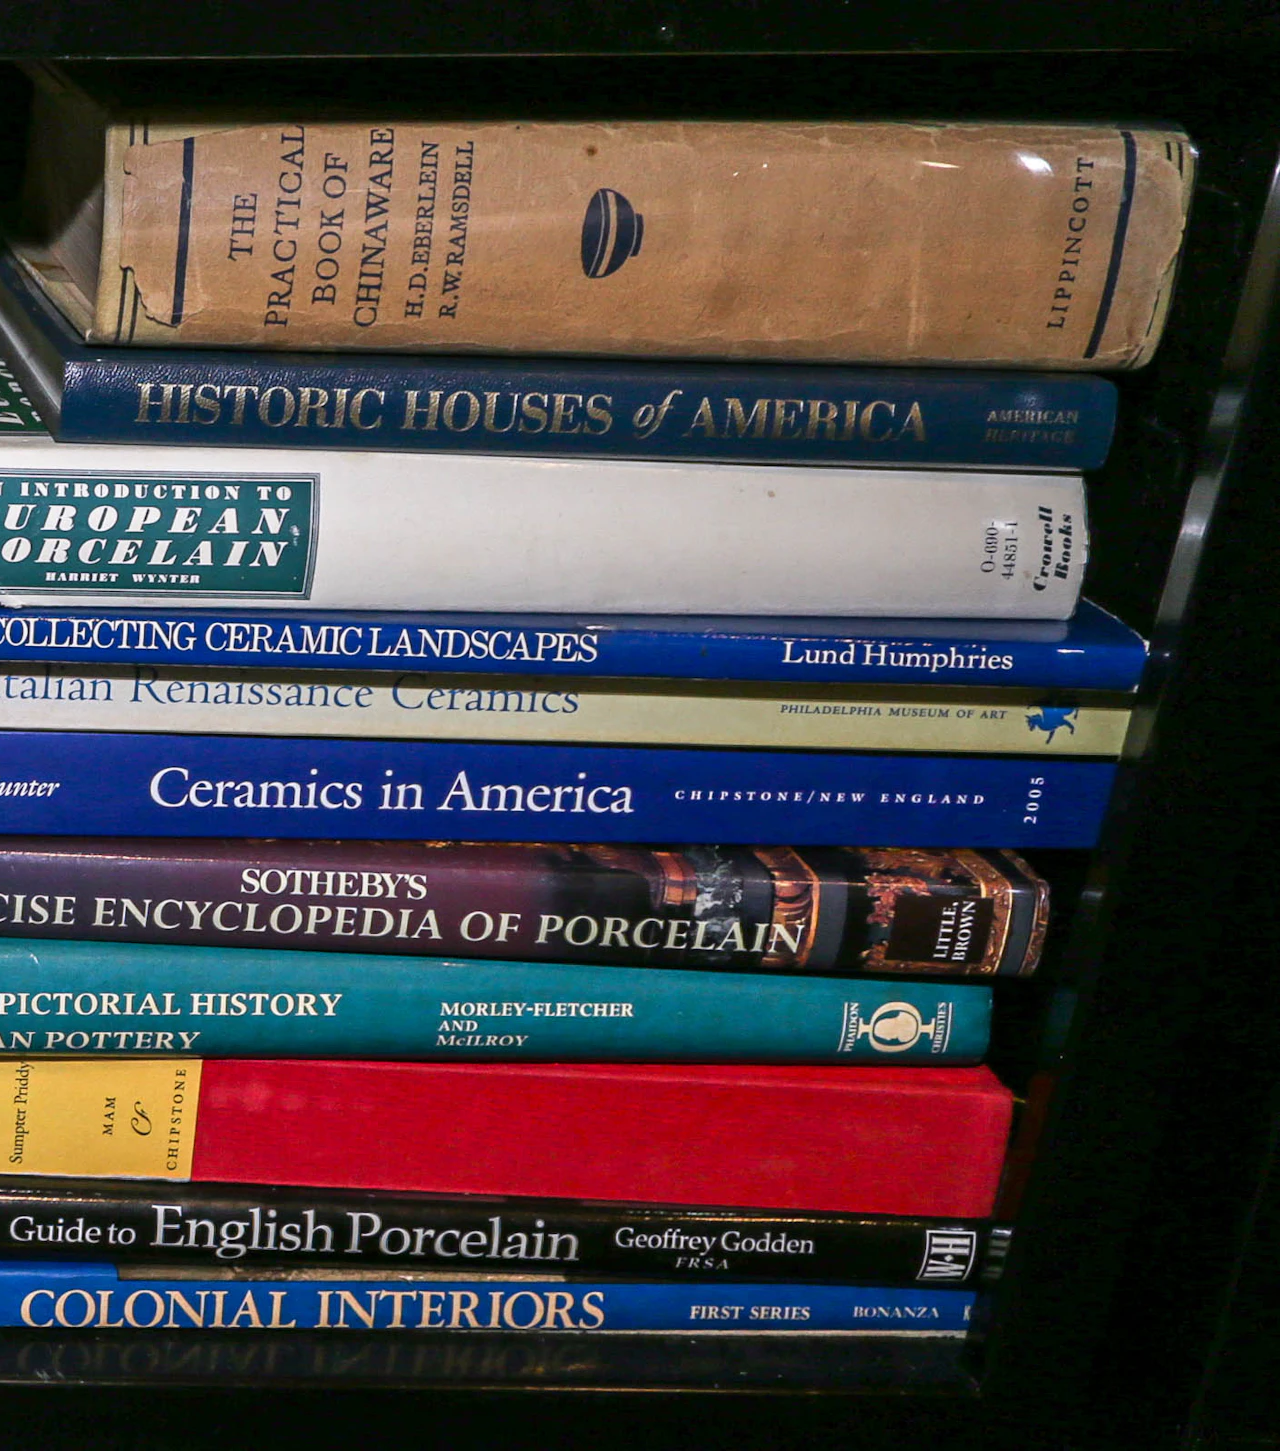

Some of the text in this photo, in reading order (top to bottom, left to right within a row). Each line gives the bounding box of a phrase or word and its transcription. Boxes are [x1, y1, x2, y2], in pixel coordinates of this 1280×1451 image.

[228, 193, 257, 261] THE
[264, 125, 305, 327] PRACTICAL
[312, 153, 348, 305] BOOK OF
[354, 128, 395, 327] CHINAWARE
[1046, 157, 1094, 329] LIPPINCOTT
[134, 382, 926, 442] HISTORIC HOUSES of AMERICA
[987, 410, 1079, 424] AMERICAN
[21, 482, 241, 501] INTRODUCTION
[256, 485, 293, 501] TO
[1033, 506, 1052, 591] Crowell
[1054, 514, 1072, 579] Books
[45, 572, 200, 584] HARRIET WYNTER
[205, 621, 362, 655] CERAMIC
[366, 626, 598, 664] LANDSCAPES
[782, 641, 1013, 672] Lund Humphries
[130, 664, 372, 708] Renaissance
[392, 674, 579, 714] Ceramics
[780, 704, 1008, 720] PHILADELPHIA MUSEUM OF ART
[150, 767, 362, 810] Ceramics
[380, 770, 422, 810] in
[437, 769, 634, 813] America
[880, 793, 985, 805] ENGLAND
[1024, 777, 1044, 824] 2005
[241, 868, 427, 900] SOTHEBY'S
[91, 898, 443, 939] ENCYCLOPEDIA
[459, 912, 521, 943] OF
[536, 915, 804, 954] PORCELAIN
[933, 902, 959, 958] LITTLE,
[952, 901, 976, 960] BROWN
[189, 993, 342, 1017] HISTORY
[438, 1020, 477, 1032] AND
[441, 1002, 633, 1018] MORLEY-FLETCHER
[843, 1002, 859, 1051] PHAIDON
[44, 1031, 200, 1050] POTTERY
[436, 1035, 528, 1046] McILROY
[9, 1061, 34, 1164] Sumpter Priddy
[102, 1096, 116, 1135] MAM
[166, 1069, 186, 1170] CHIPSTONE
[9, 1216, 100, 1244] Guide
[107, 1222, 136, 1246] to
[151, 1205, 334, 1258] English
[343, 1212, 579, 1260] Porcelain
[614, 1226, 814, 1256] Geoffrey Godden
[20, 1289, 604, 1330] COLONIAL INTERIORS
[690, 1305, 810, 1320] FIRST SERIES
[853, 1306, 939, 1319] BONANZA
